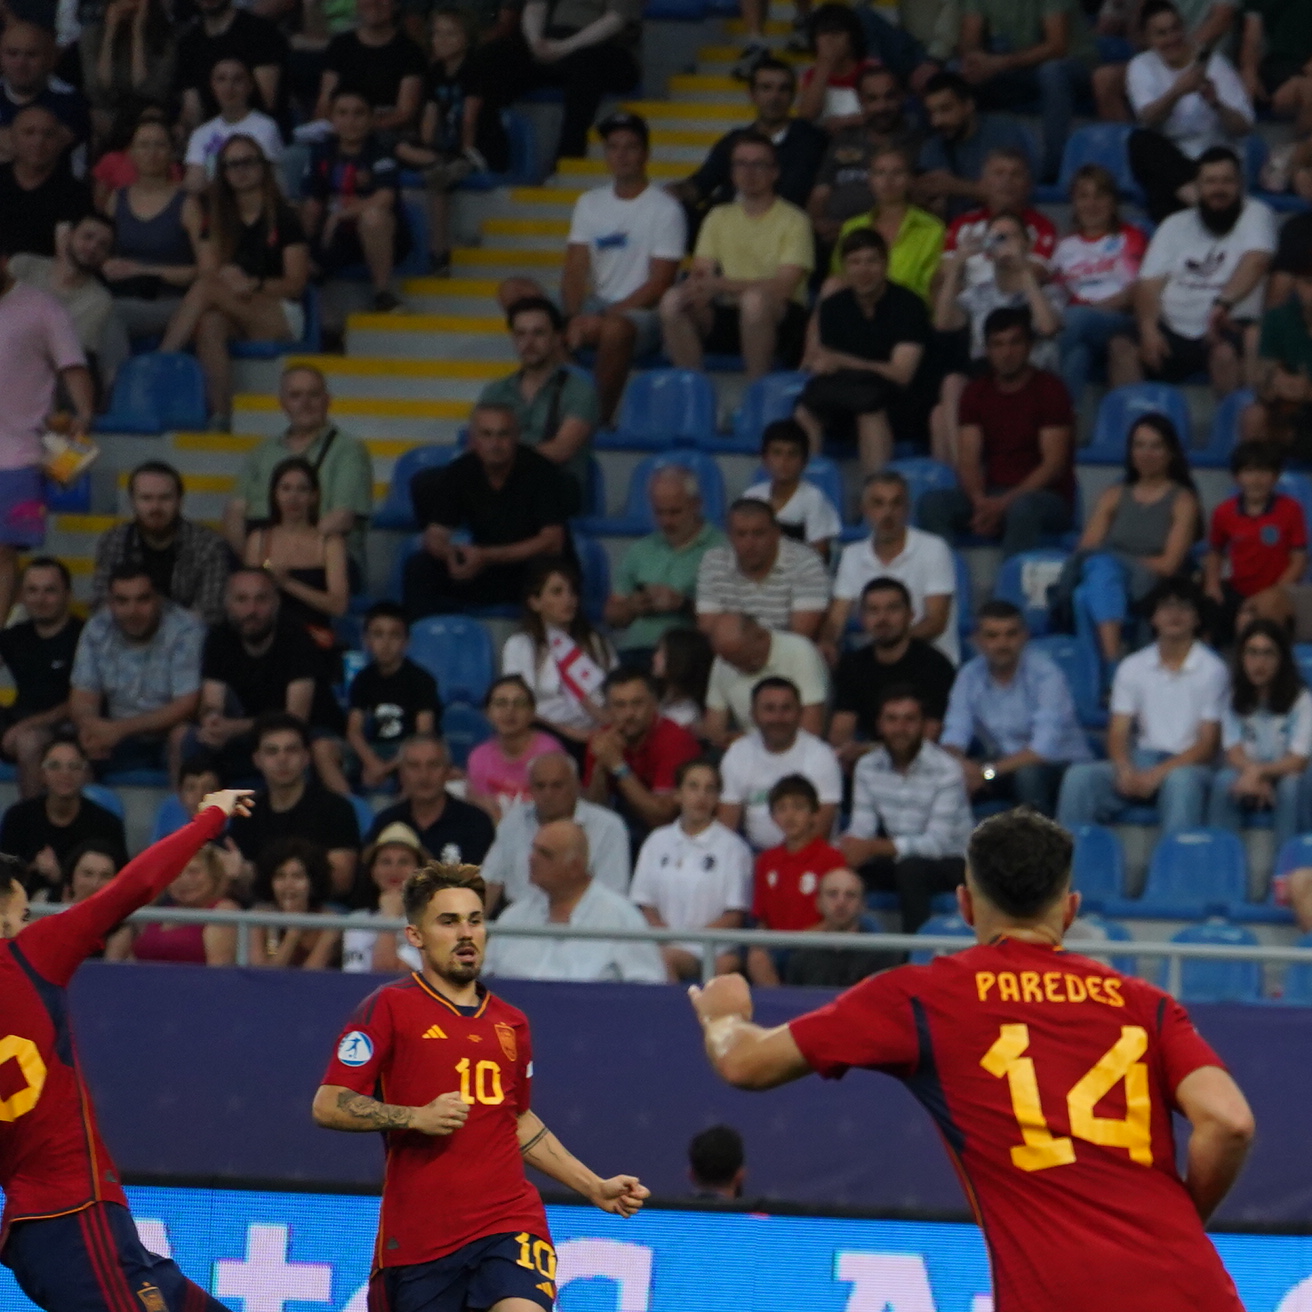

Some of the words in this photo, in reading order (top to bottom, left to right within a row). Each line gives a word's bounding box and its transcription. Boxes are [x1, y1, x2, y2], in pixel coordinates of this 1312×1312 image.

[975, 971, 1126, 1008] PAREDES
[454, 1057, 505, 1106] 10
[979, 1022, 1155, 1173] 14
[514, 1231, 558, 1281] 10
